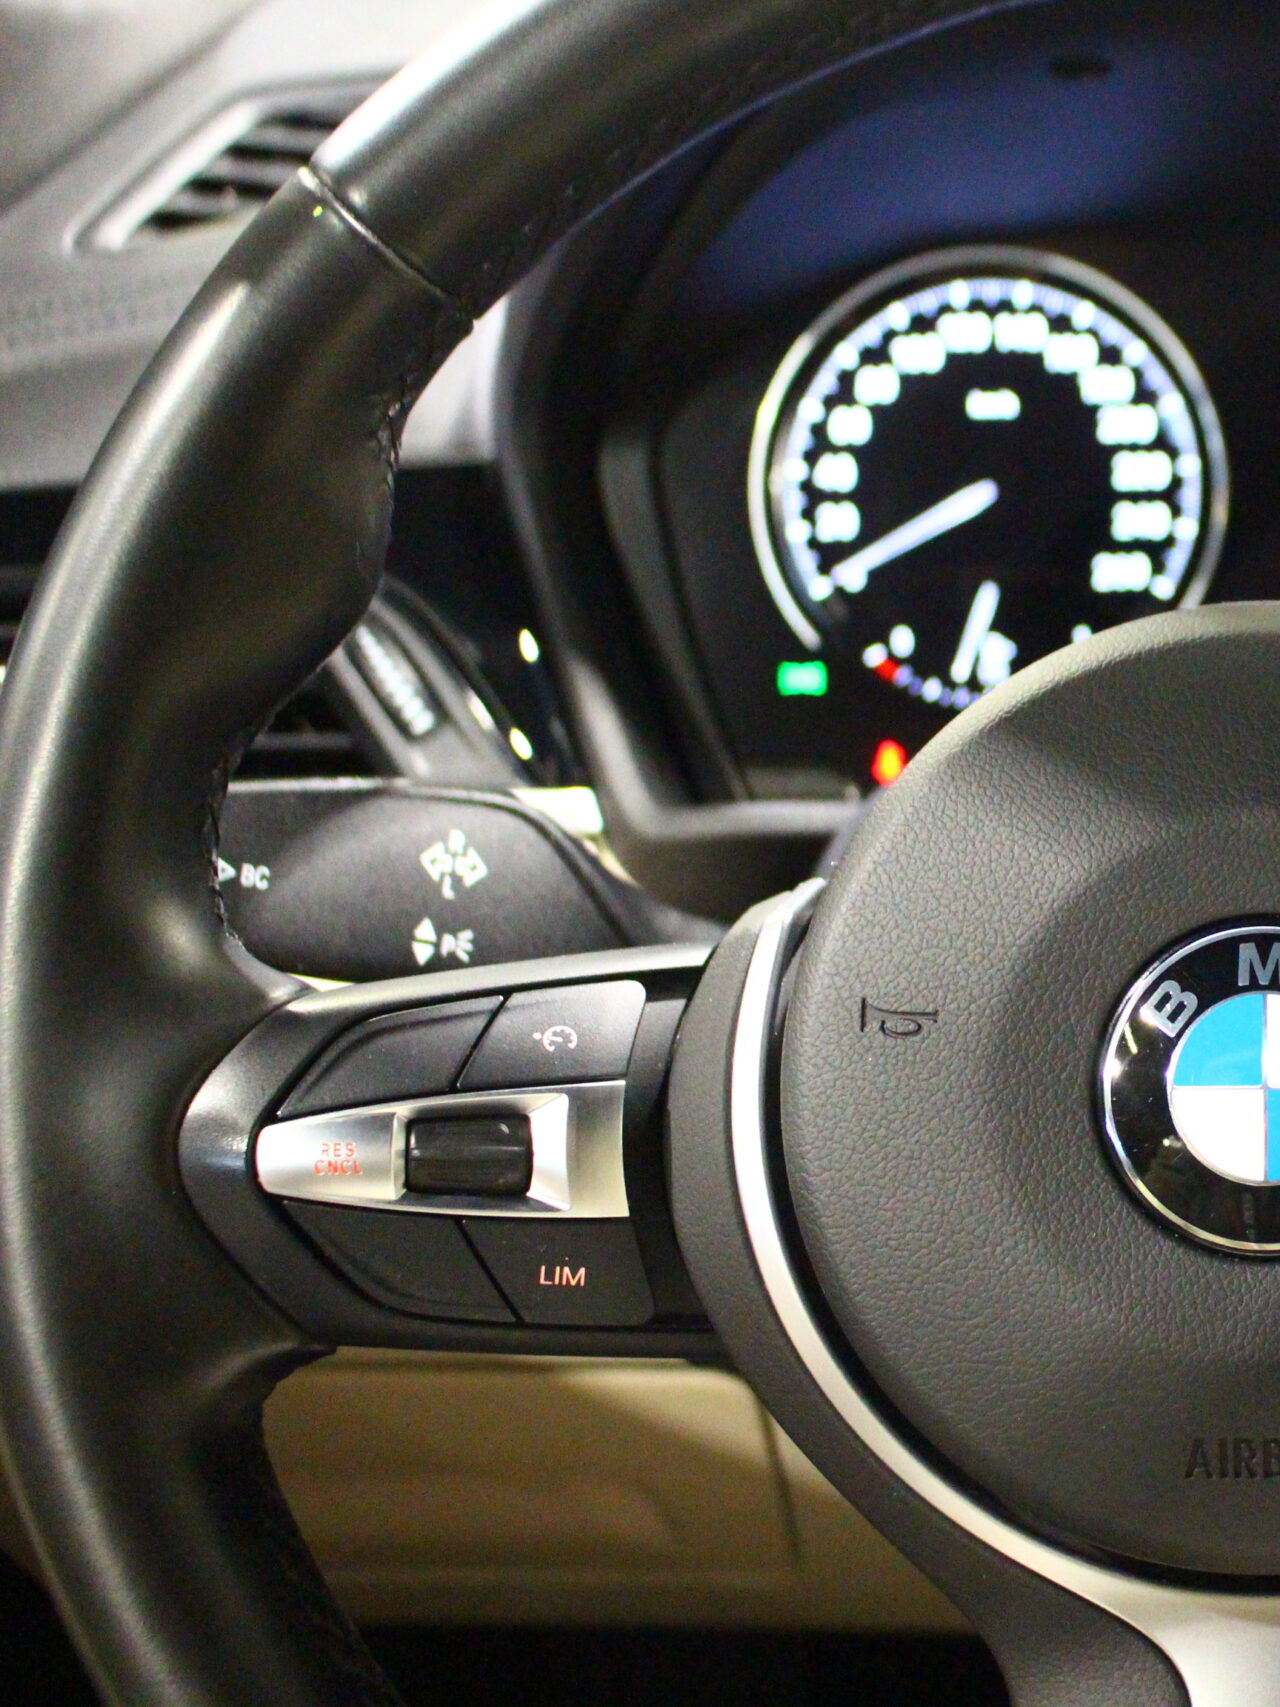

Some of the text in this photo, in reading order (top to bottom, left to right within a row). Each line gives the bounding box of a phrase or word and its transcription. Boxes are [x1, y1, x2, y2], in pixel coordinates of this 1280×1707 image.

[240, 863, 271, 891] BC
[321, 1141, 356, 1158] RES
[313, 1159, 363, 1176] CNCL
[538, 1265, 586, 1287] LIM
